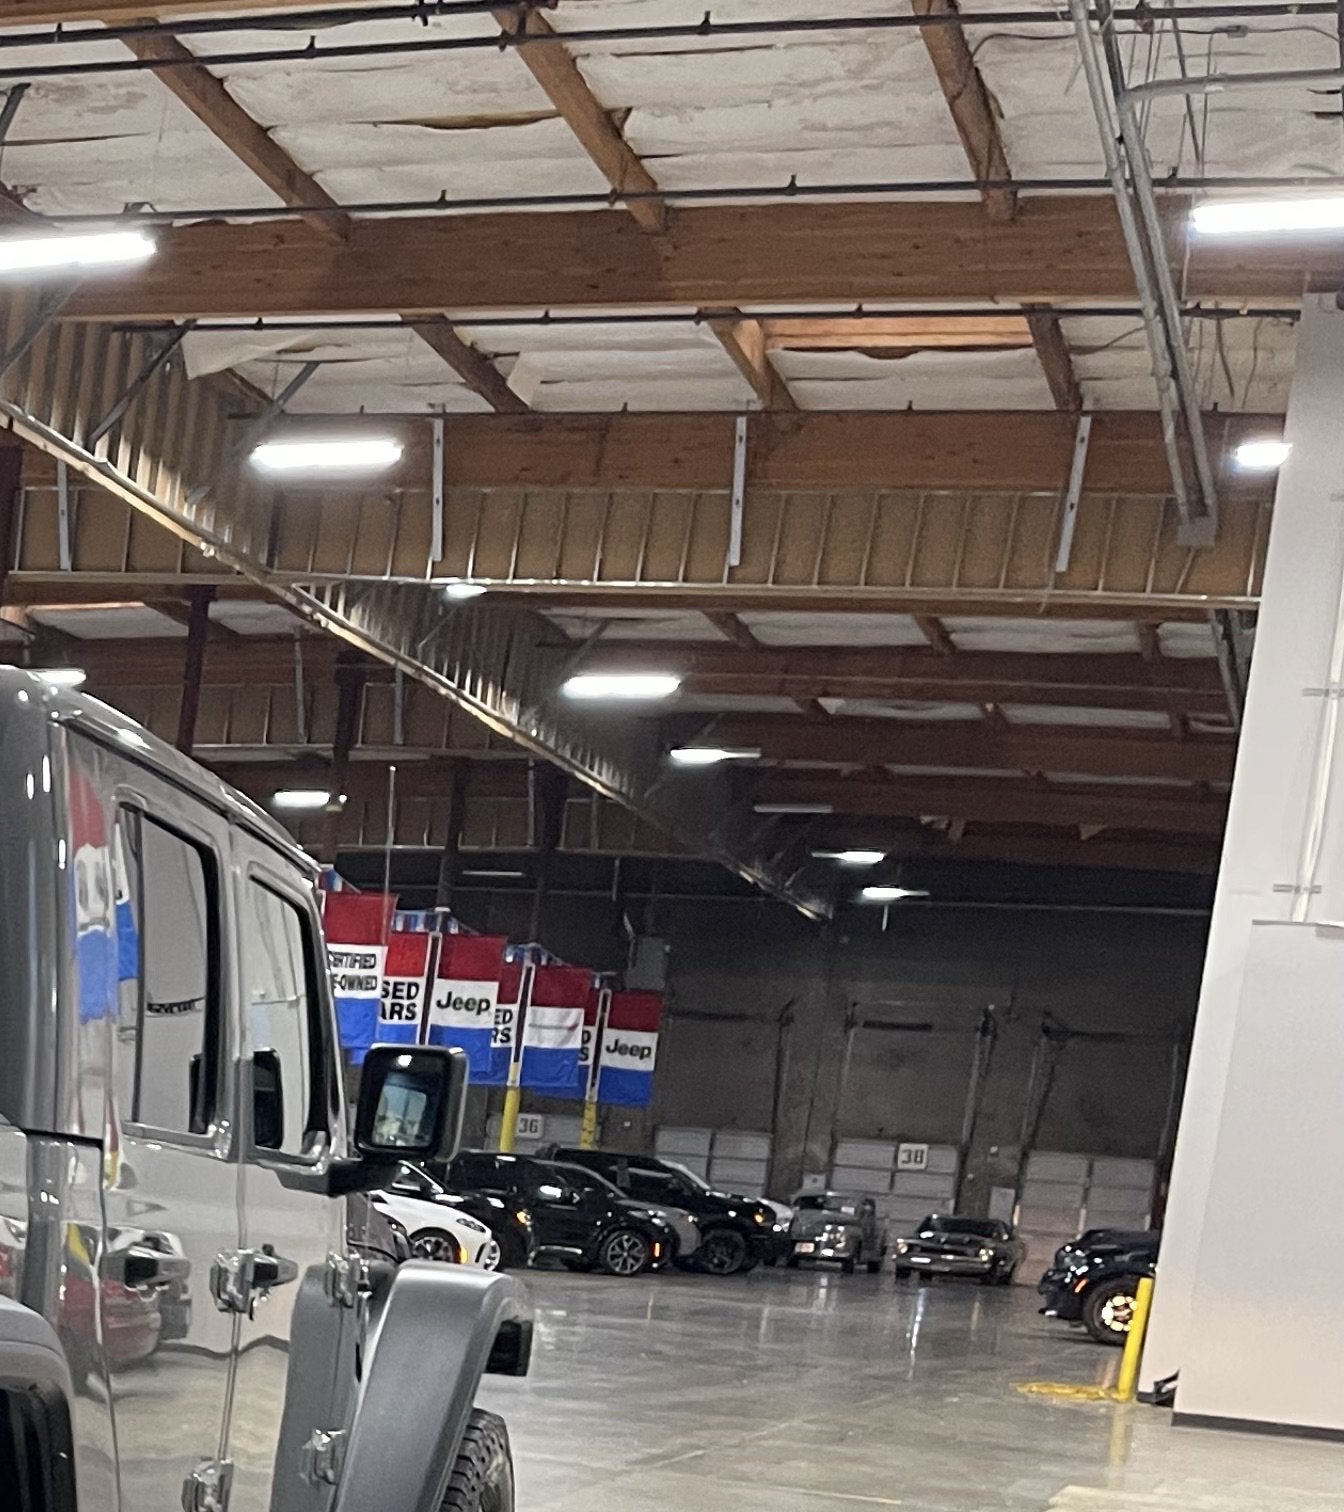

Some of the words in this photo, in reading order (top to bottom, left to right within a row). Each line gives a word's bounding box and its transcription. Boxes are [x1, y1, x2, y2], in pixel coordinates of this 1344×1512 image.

[328, 950, 377, 969] ERTIFIED
[330, 974, 377, 991] E-OWNED
[381, 980, 420, 1001] SED
[380, 1002, 417, 1021] ARS
[436, 990, 491, 1016] Jeep
[605, 1038, 652, 1060] Jeep
[518, 1117, 539, 1134] 36
